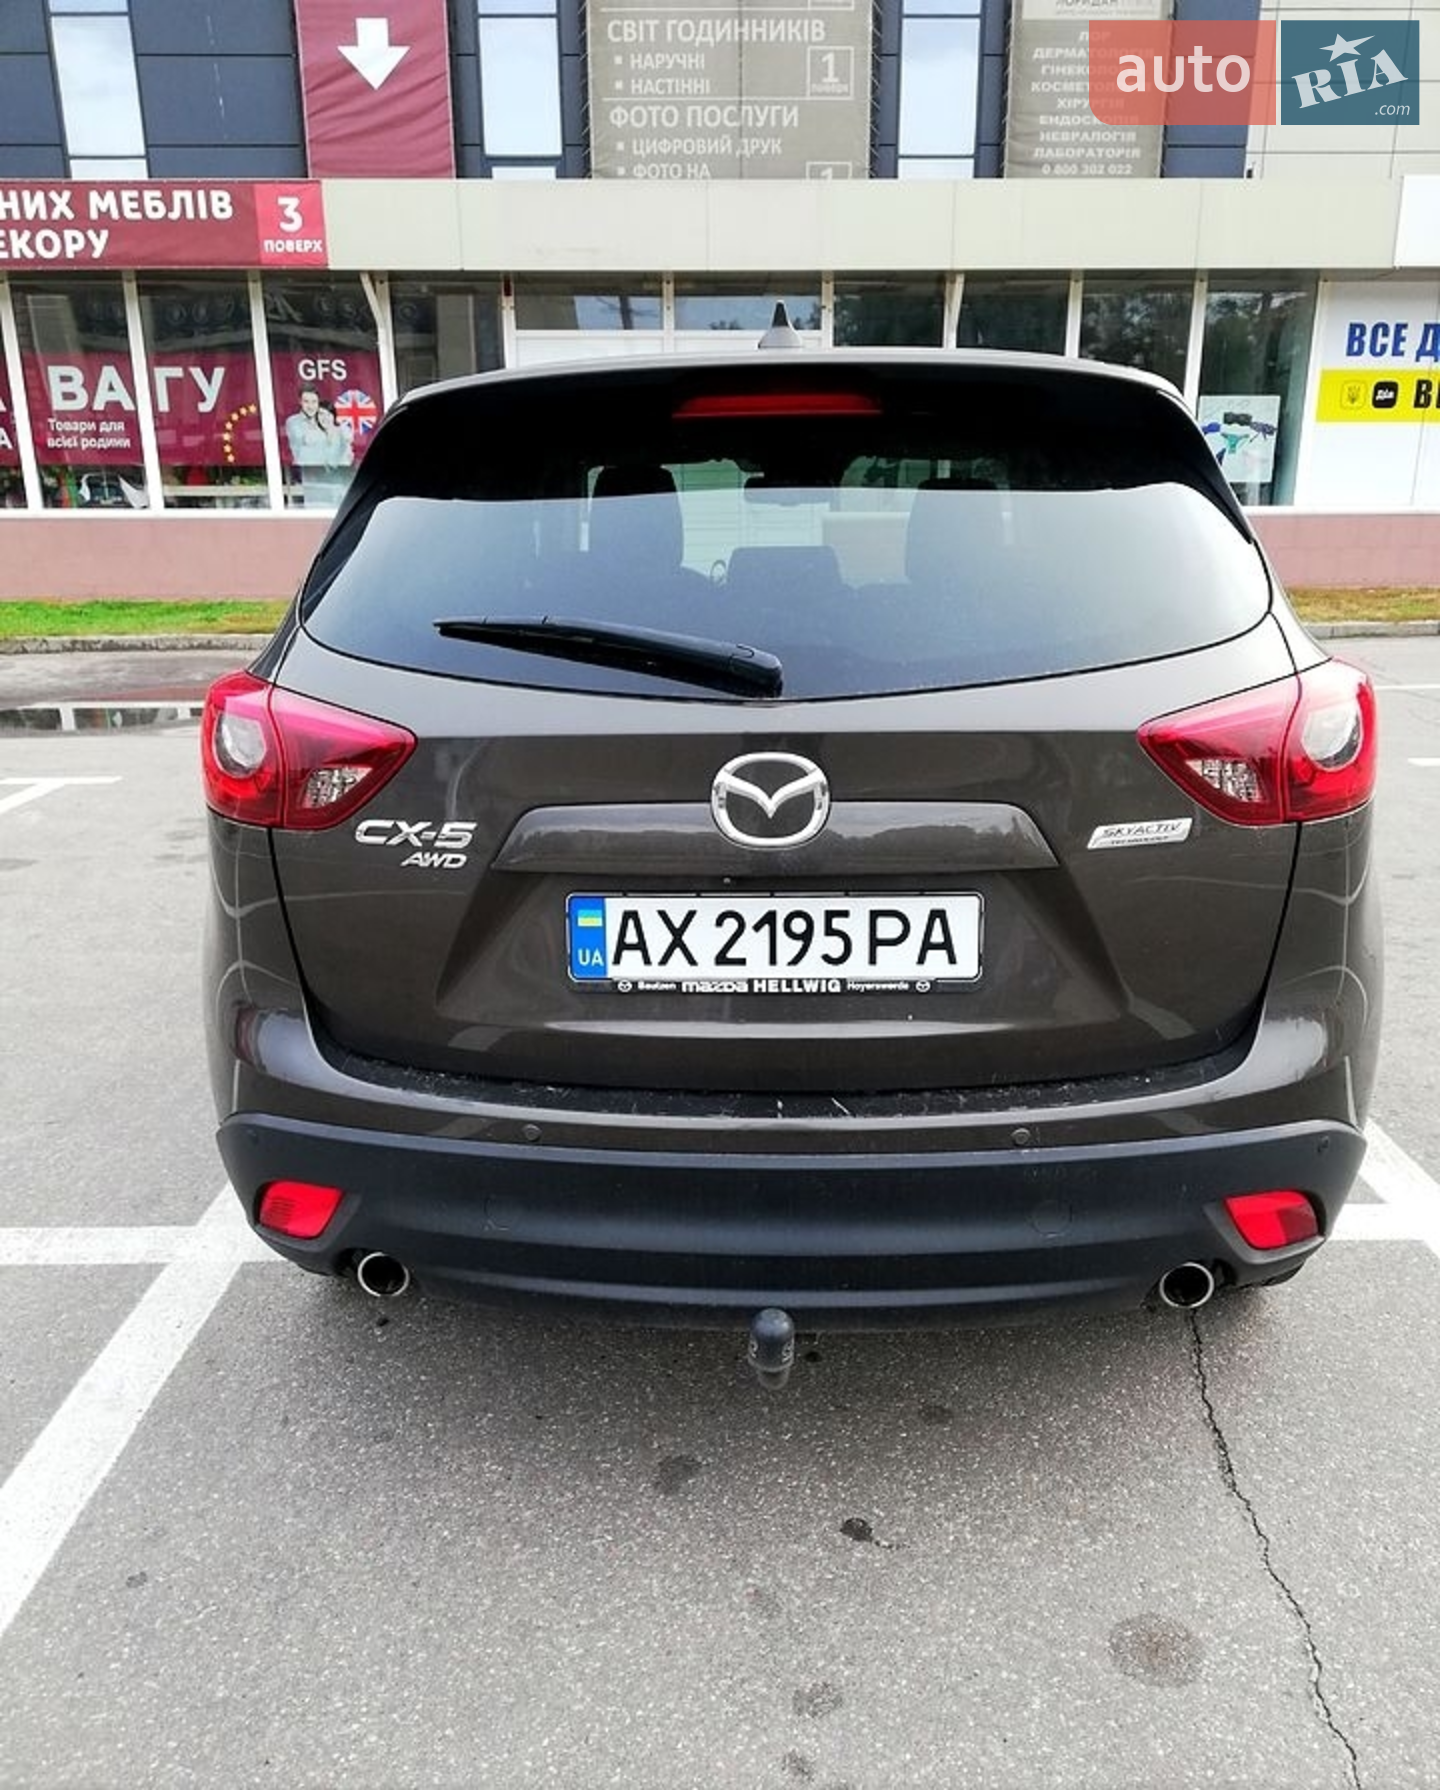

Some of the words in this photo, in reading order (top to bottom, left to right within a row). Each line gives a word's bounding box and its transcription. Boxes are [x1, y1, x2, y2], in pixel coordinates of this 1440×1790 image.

[606, 20, 659, 42] СВІТ
[666, 19, 826, 47] ГОДИННИКІВ
[630, 54, 705, 69] НАРУЧНІ
[821, 52, 840, 83] 1
[631, 79, 711, 95] НАСТІННІ
[609, 105, 679, 127] ФОТО
[686, 105, 799, 127] ПОСЛУГИ
[631, 135, 731, 158] ЦИФРОВИЙ
[735, 138, 783, 156] ДРУК
[1033, 147, 1141, 159] ЛАБОРАТОРІЯ
[632, 163, 682, 178] ФОТО
[687, 164, 711, 178] НА
[0, 189, 75, 220] НИХ
[89, 190, 234, 220] МЕБЛІВ
[276, 196, 303, 232] 3
[263, 239, 323, 253] ПОВЕРХ
[1346, 322, 1408, 357] ВСЕ
[298, 359, 347, 381] GFS
[47, 417, 97, 434] Товари
[355, 819, 478, 849] CX-5
[1103, 822, 1182, 838] SKYACTIV
[400, 852, 467, 868] AWD
[612, 909, 699, 966] AX
[714, 909, 853, 966] 2195
[867, 908, 958, 966] PA
[577, 949, 605, 967] UA
[753, 979, 842, 993] HELLWIG
